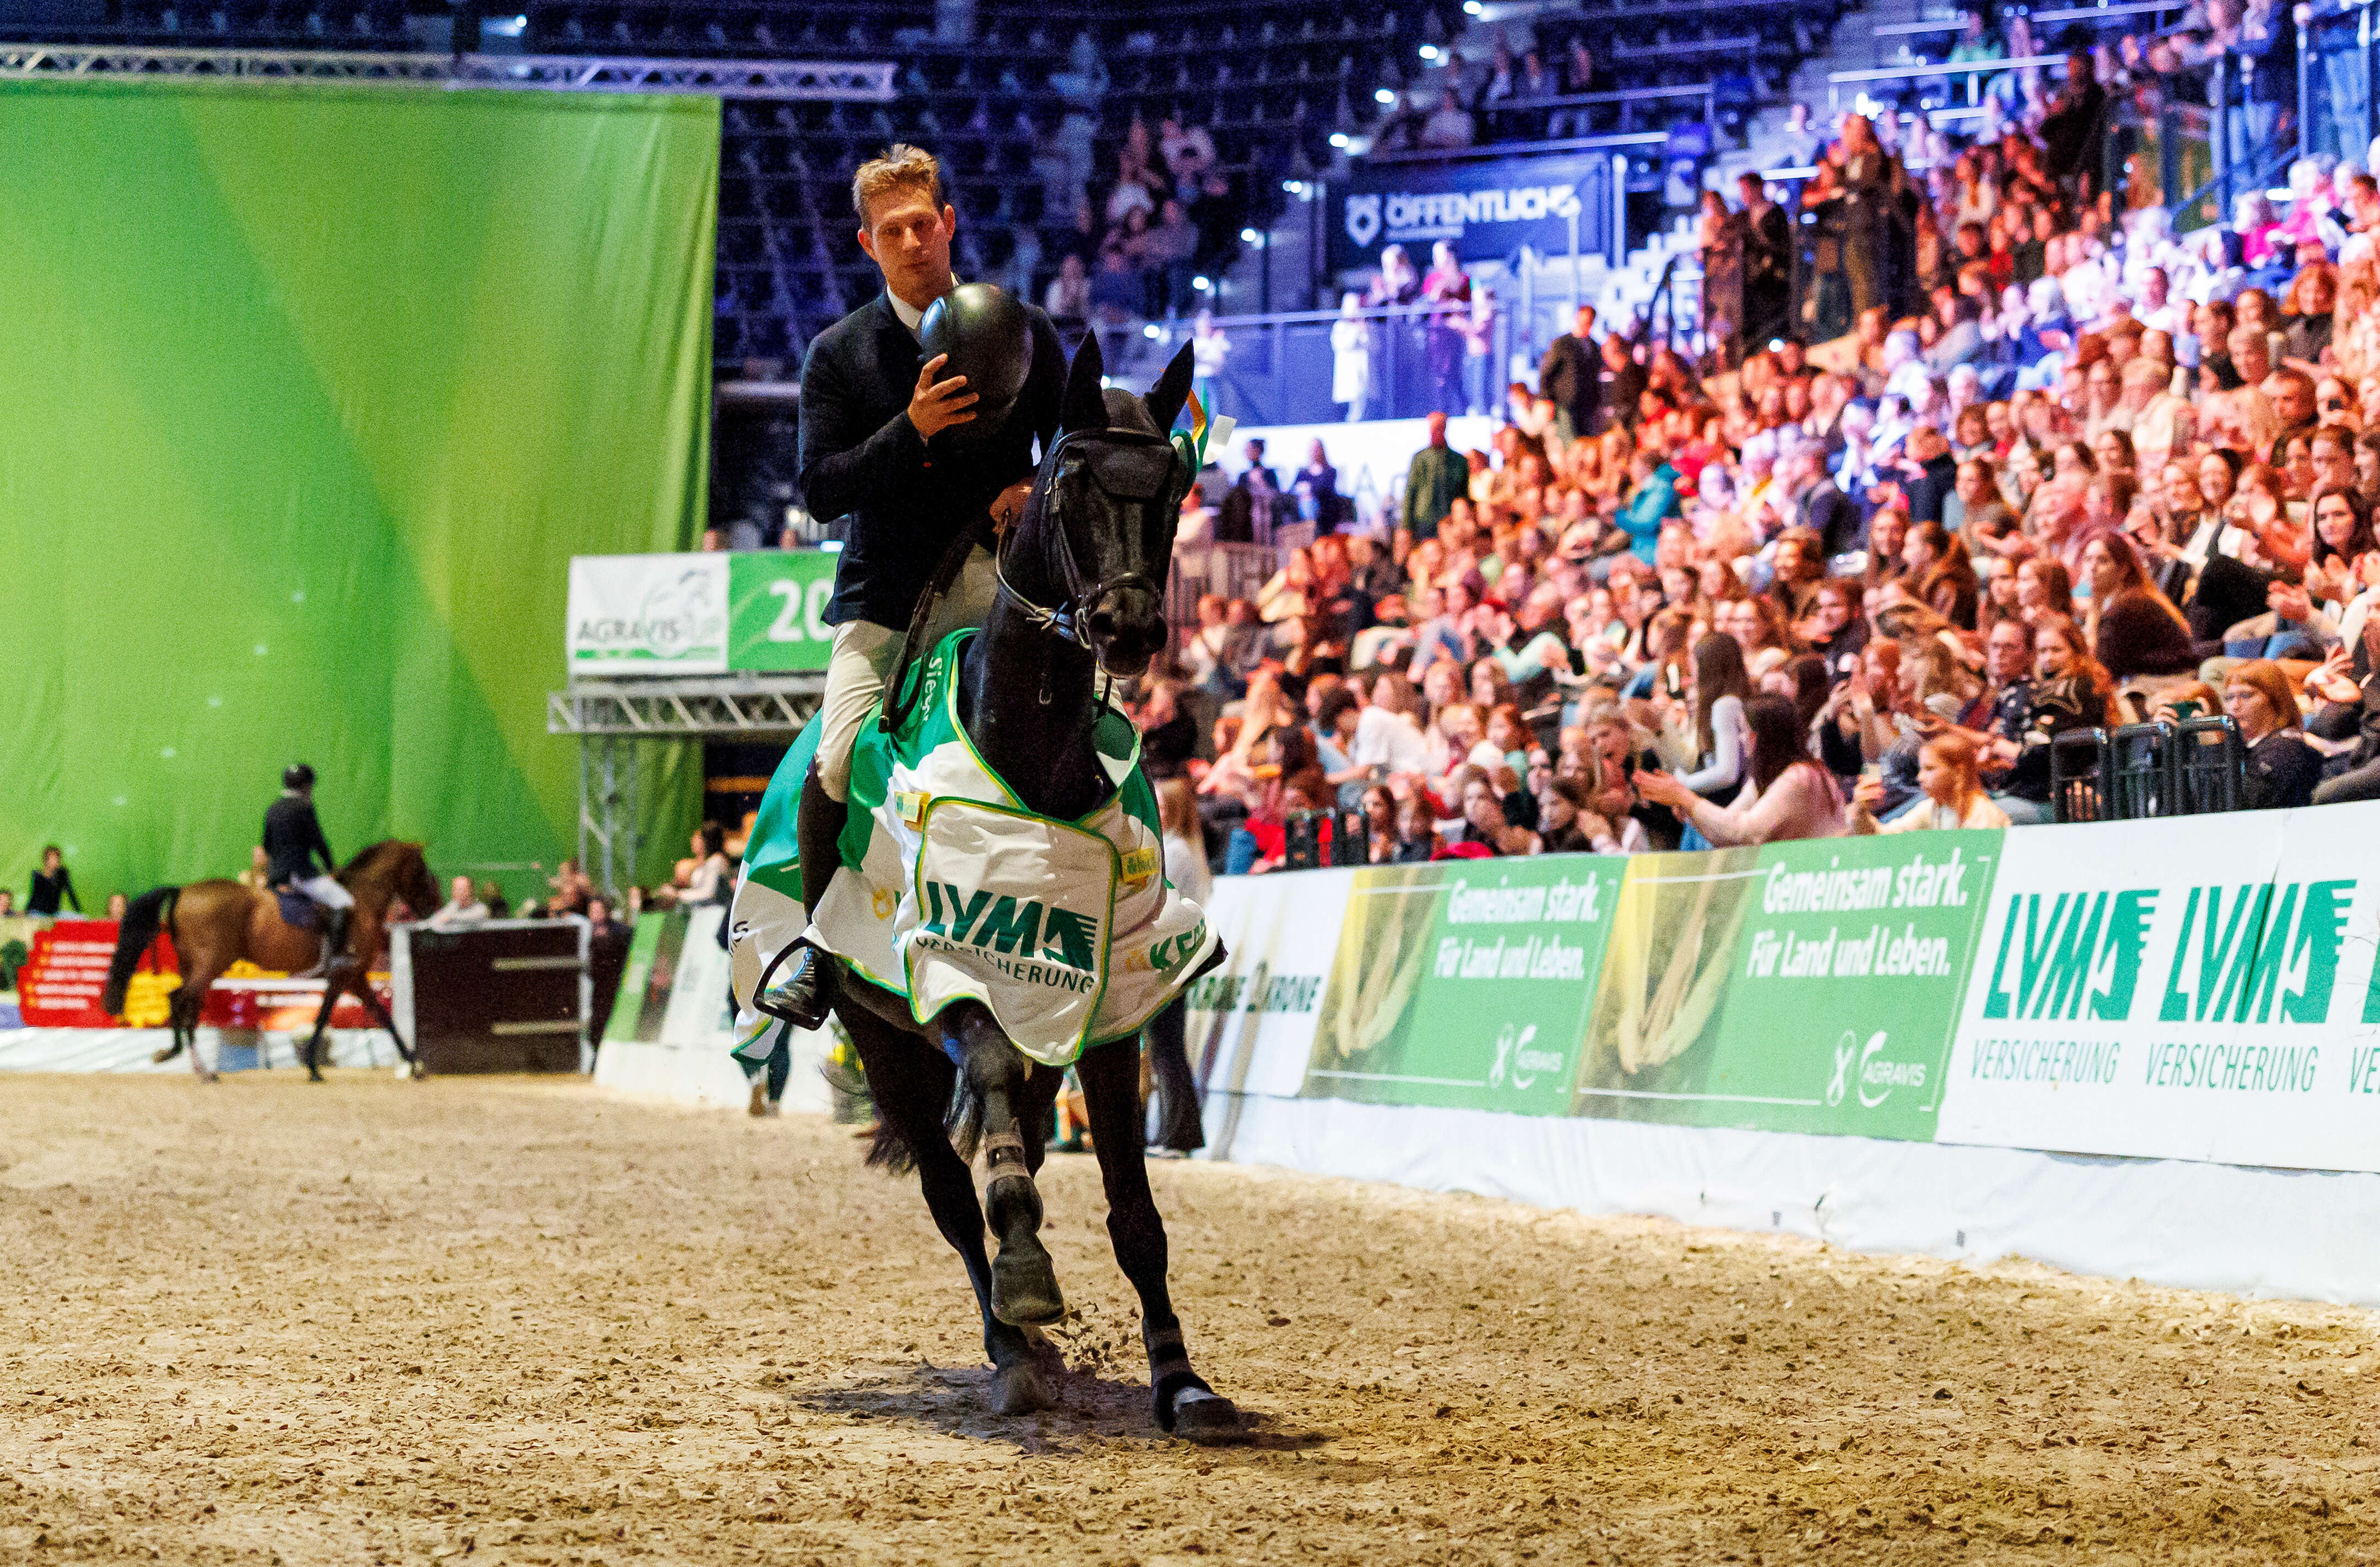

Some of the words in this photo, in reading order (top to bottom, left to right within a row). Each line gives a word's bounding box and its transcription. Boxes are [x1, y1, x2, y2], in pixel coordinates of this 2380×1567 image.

[1447, 875, 1547, 924] Gemeinsam
[1544, 870, 1599, 922] stark.
[1764, 855, 1892, 913] Gemeinsam
[1892, 847, 1968, 908] stark.
[924, 881, 1044, 958] LVM
[1434, 936, 1462, 978] Für
[1460, 935, 1505, 978] Land
[1499, 934, 1535, 978] und
[1529, 933, 1584, 979] Leben.
[1746, 929, 1783, 978] Für
[1779, 925, 1838, 978] Land
[1833, 924, 1879, 977] und
[1874, 921, 1952, 977] Leben.
[1983, 891, 2109, 1021] LVM
[2158, 883, 2300, 1023] LVM
[1265, 974, 1322, 1013] KRONE
[1862, 1060, 1927, 1088] AGRAVIS
[1971, 1038, 2121, 1085] VERSICHERUNG
[2146, 1043, 2319, 1092] VERSICHERUNG
